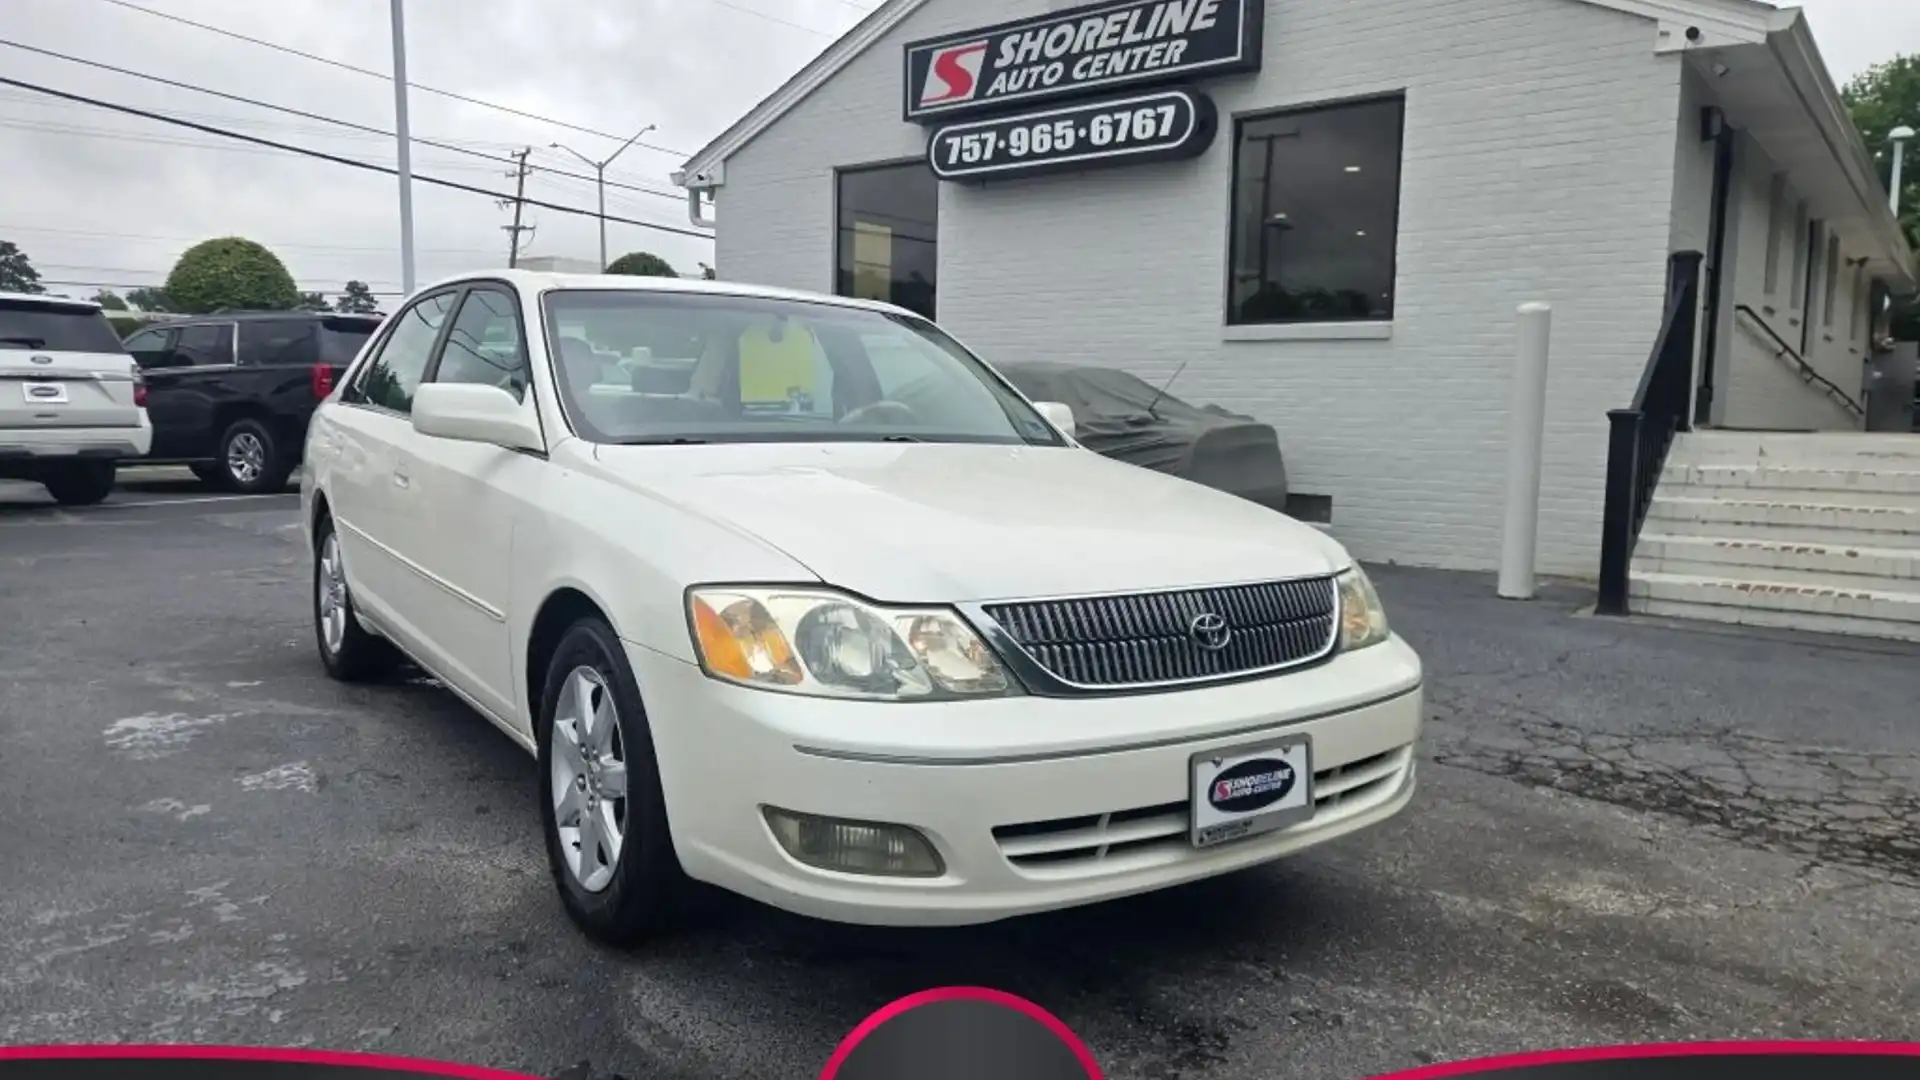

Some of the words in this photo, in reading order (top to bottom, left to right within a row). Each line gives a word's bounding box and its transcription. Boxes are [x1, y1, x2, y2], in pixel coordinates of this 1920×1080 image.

[993, 0, 1219, 69] SHORELINE
[984, 61, 1064, 97] AUTO
[1071, 39, 1188, 81] CENTER
